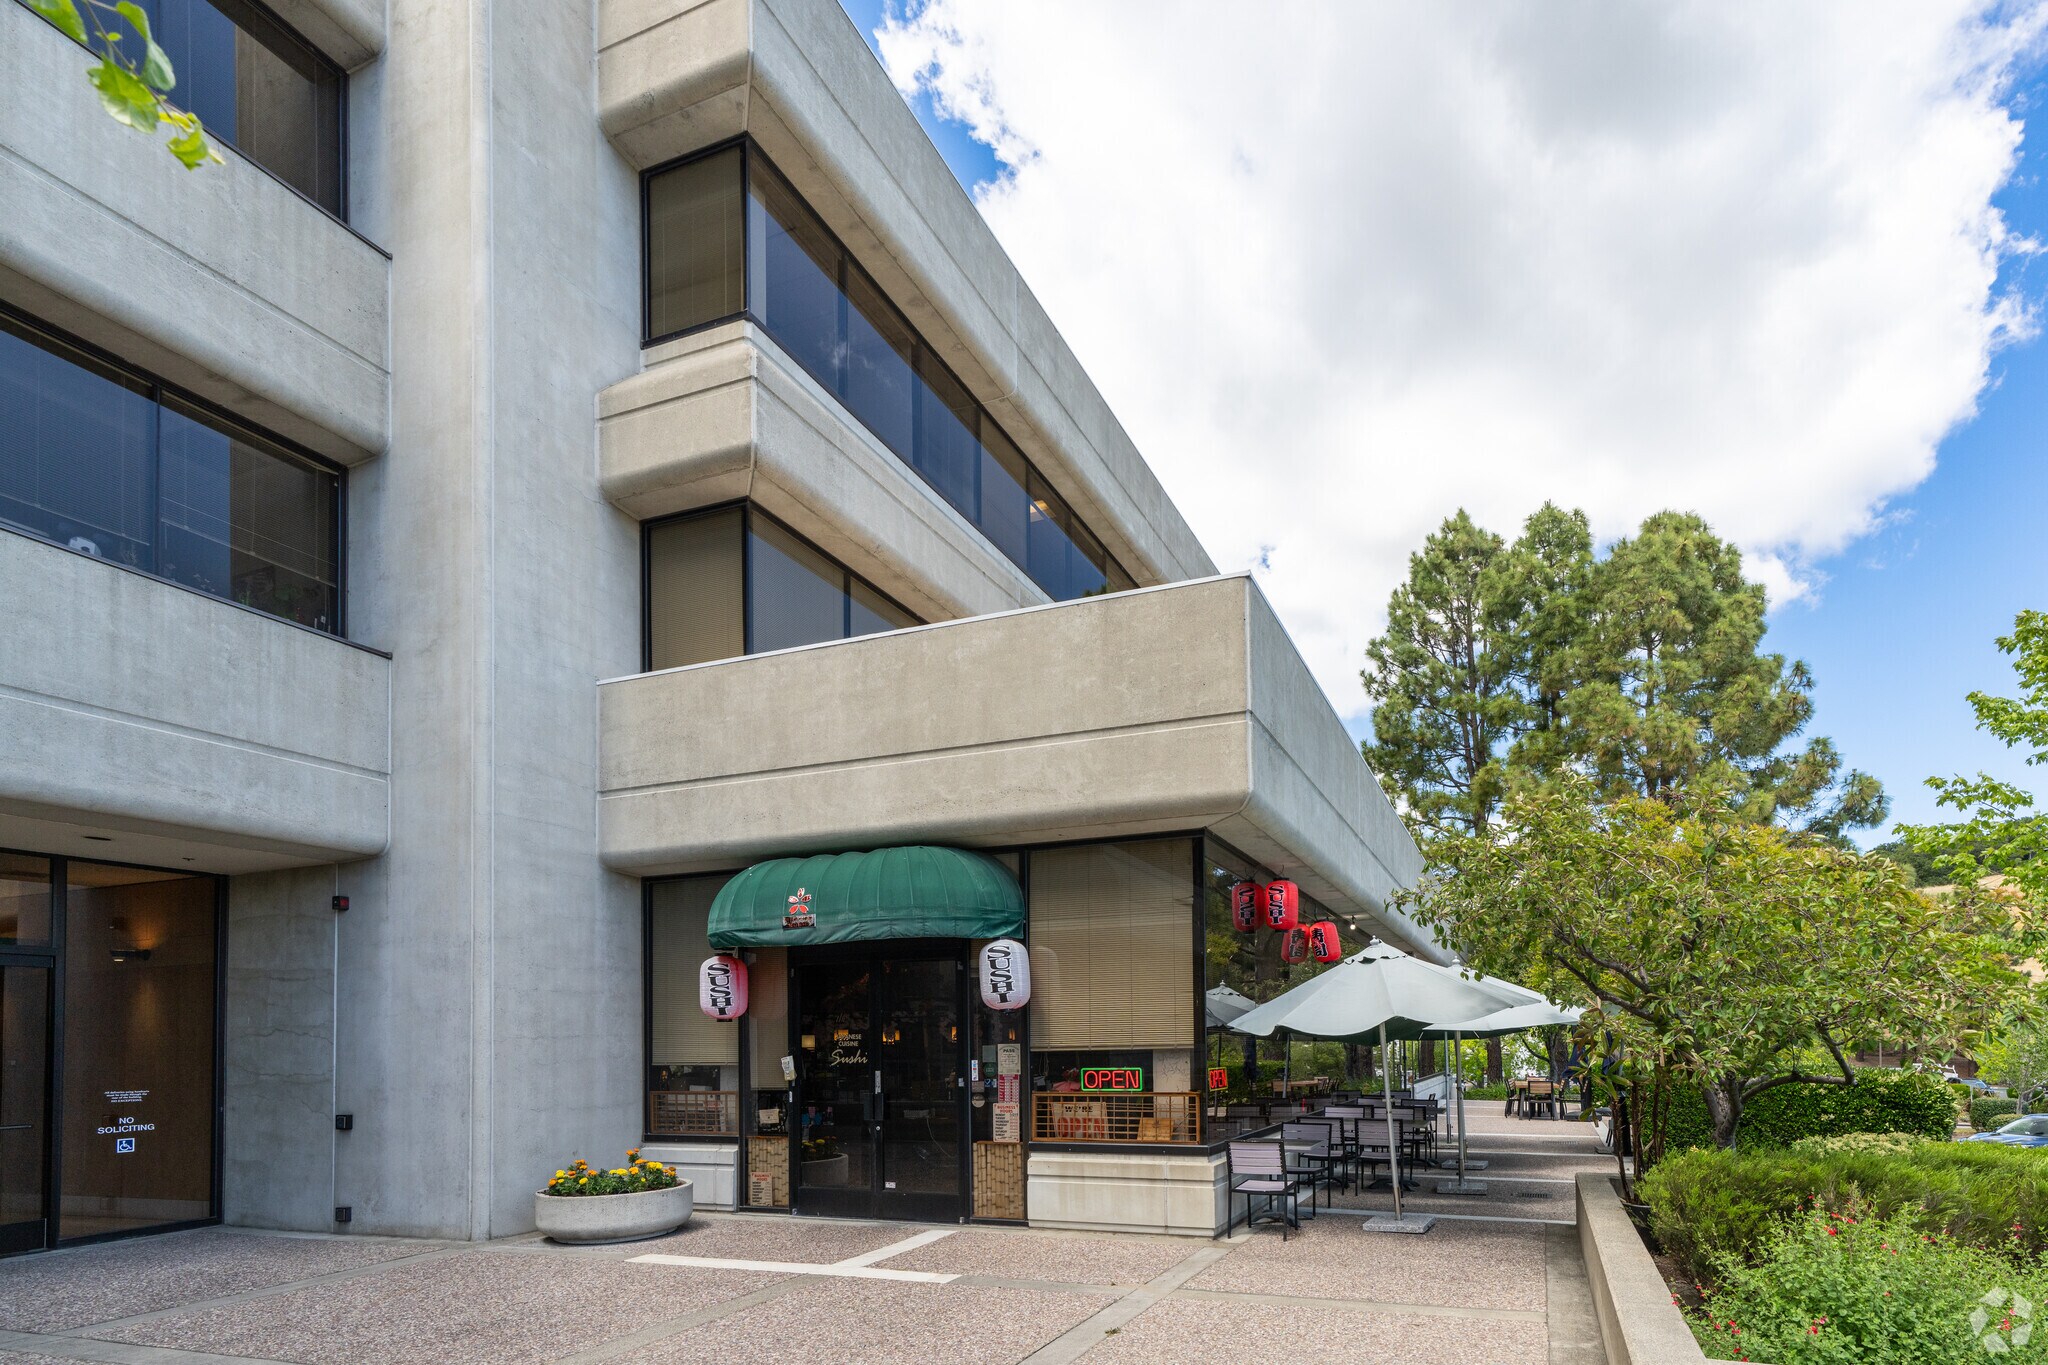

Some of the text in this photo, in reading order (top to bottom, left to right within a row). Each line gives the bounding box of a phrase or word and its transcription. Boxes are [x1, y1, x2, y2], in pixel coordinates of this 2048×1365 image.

[1268, 885, 1284, 924] SUSHI
[987, 945, 1014, 1004] SUSHI
[707, 963, 732, 1016] SUSHI
[830, 1048, 868, 1067] Sushi
[1084, 1070, 1139, 1089] OPEN
[1210, 1069, 1227, 1089] OPEN
[97, 1123, 155, 1135] SOLICITING
[118, 1116, 135, 1124] NO
[1057, 1117, 1105, 1139] OPEN
